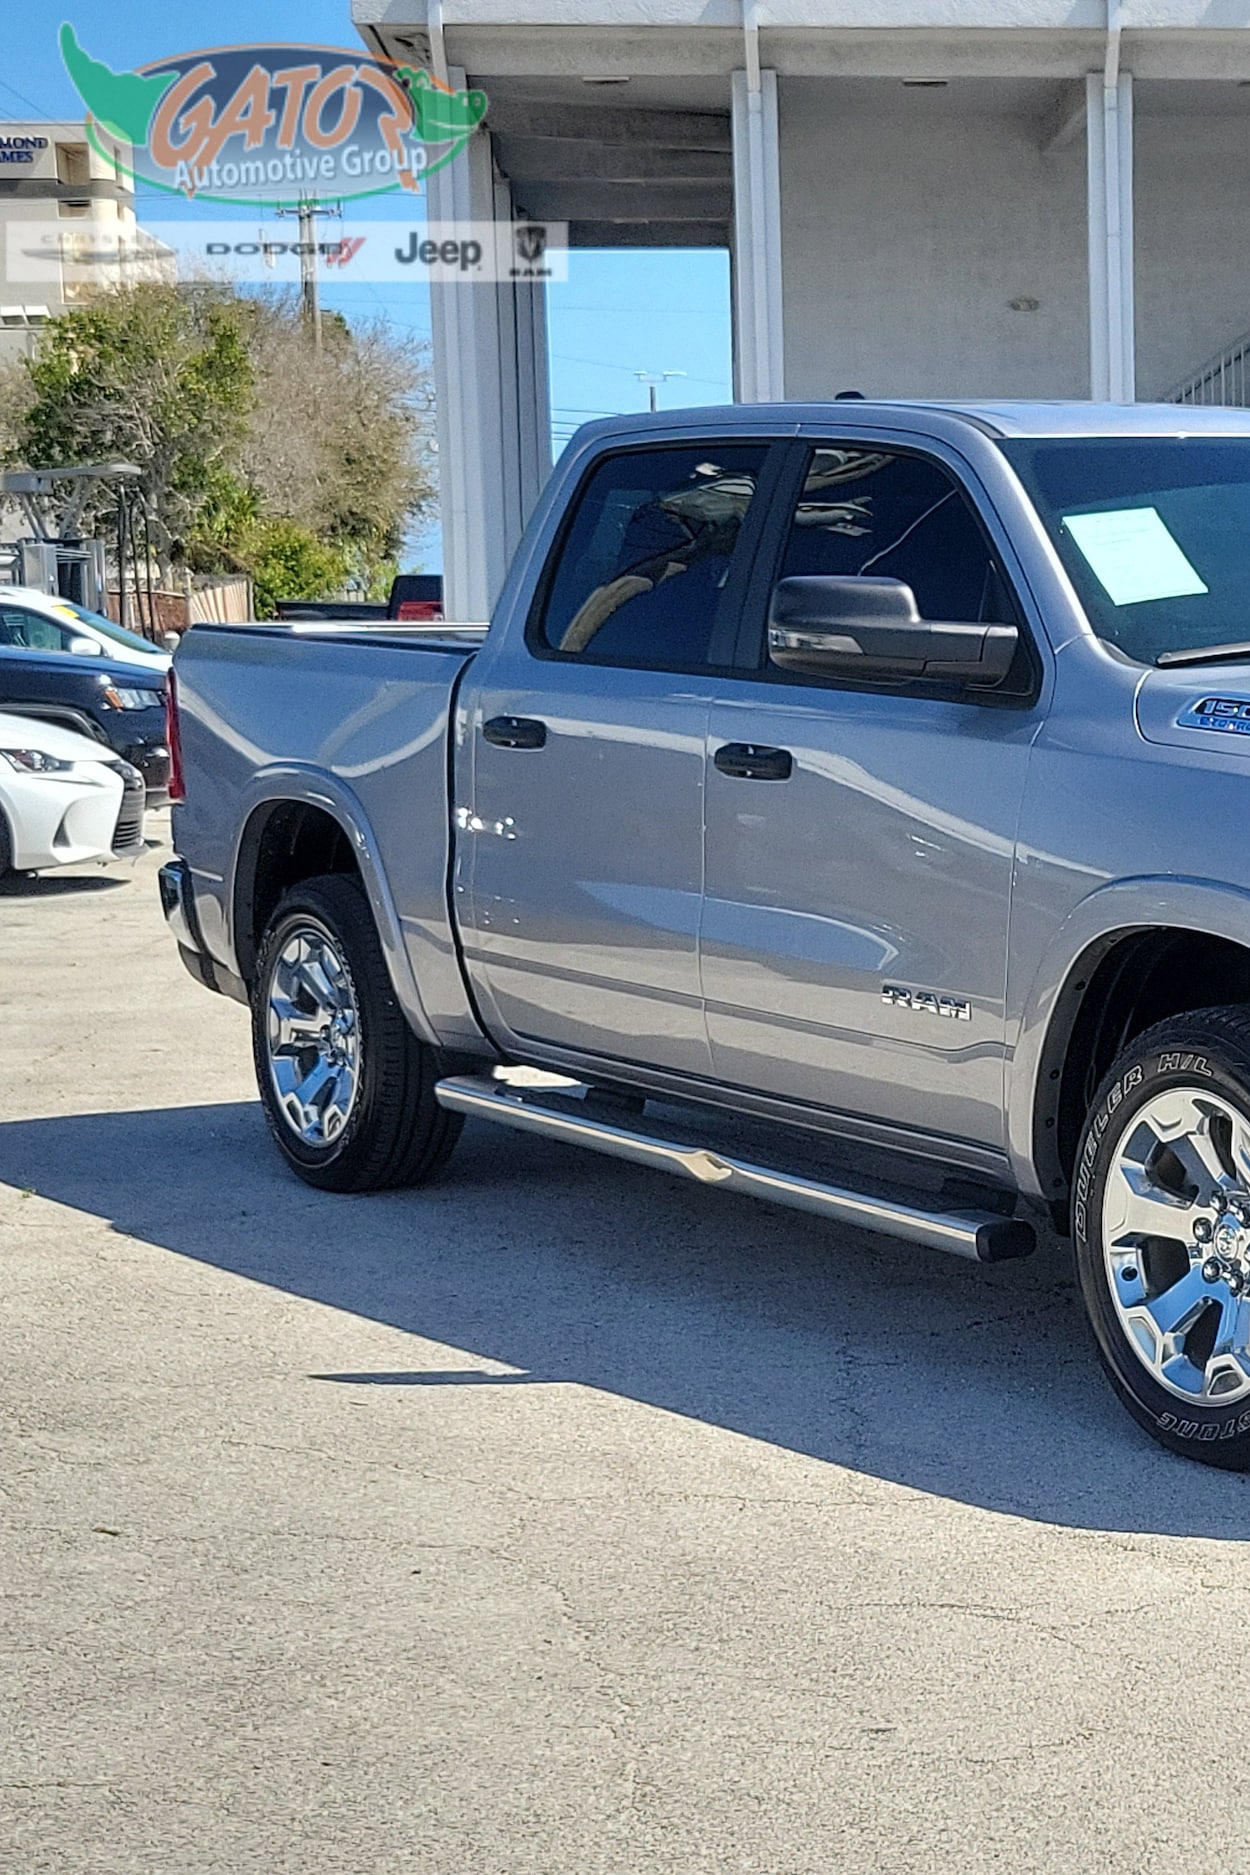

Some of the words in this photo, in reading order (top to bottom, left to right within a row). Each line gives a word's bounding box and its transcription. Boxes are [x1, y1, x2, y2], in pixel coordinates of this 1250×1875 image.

[881, 984, 972, 1021] RAM
[1075, 1065, 1142, 1242] DUELER
[1157, 1053, 1213, 1077] H/L
